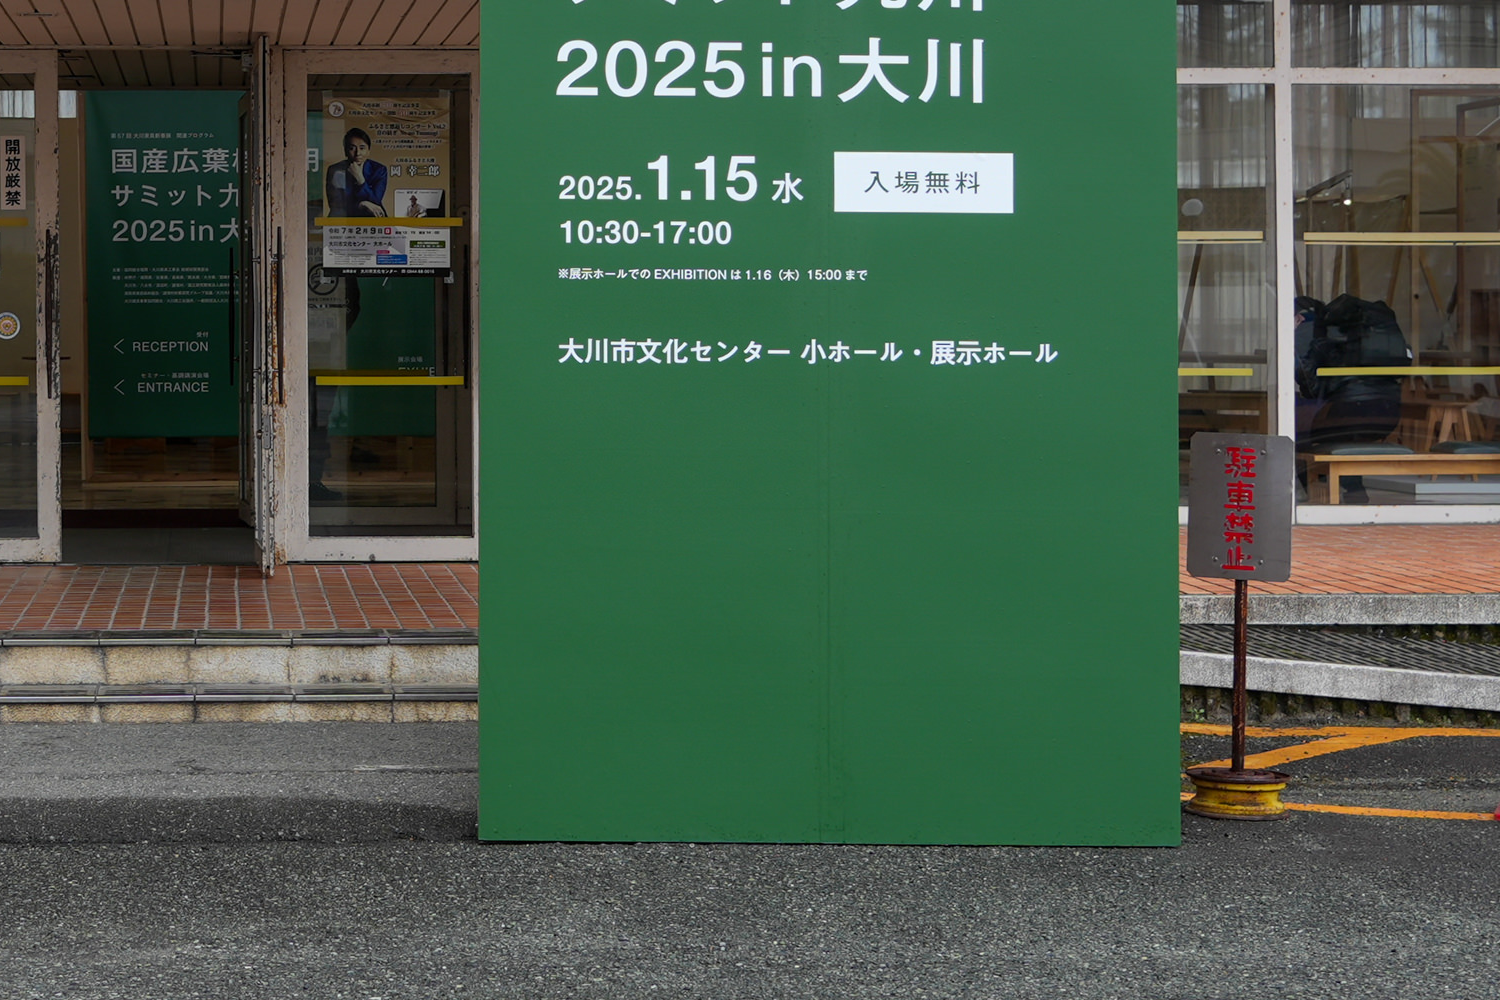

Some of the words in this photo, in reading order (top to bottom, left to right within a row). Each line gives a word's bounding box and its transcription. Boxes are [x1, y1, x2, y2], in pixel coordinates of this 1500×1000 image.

[4, 138, 22, 207] 開放厳禁
[864, 170, 982, 195] 入場無料
[110, 182, 239, 208] サミット九
[560, 219, 732, 245] 10:30-17:00
[132, 340, 209, 353] RECEPTION
[137, 381, 210, 393] ENTRANCE
[1222, 445, 1258, 572] 駐車禁止
